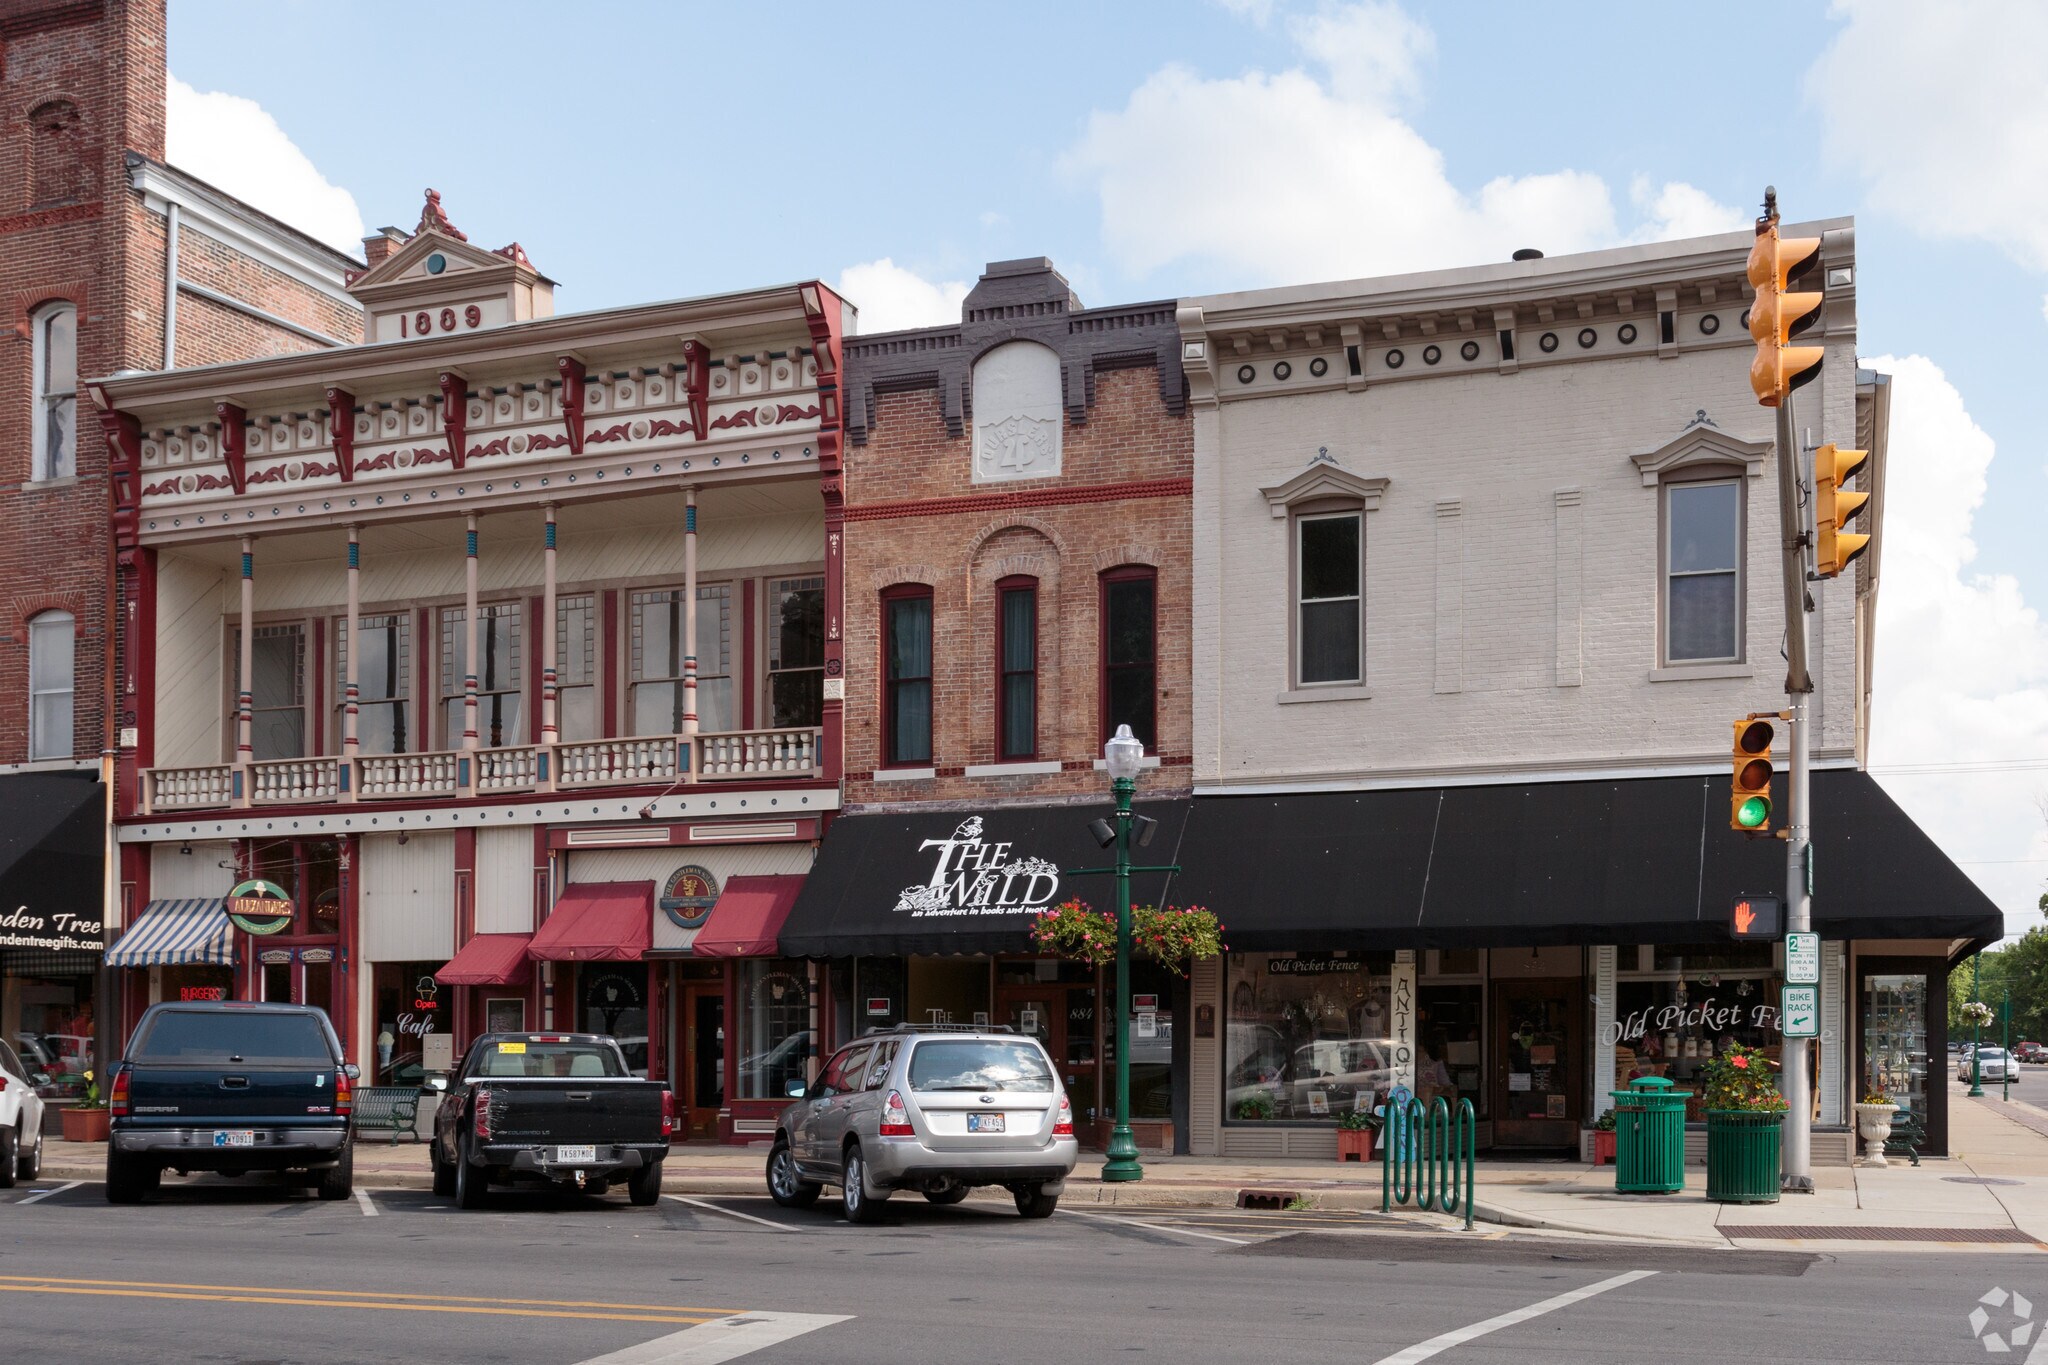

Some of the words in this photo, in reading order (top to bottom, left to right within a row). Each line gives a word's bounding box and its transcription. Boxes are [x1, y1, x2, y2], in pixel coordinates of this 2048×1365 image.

[401, 304, 481, 338] 1889
[918, 838, 1012, 900] THE
[937, 871, 1059, 907] WILD
[0, 905, 44, 930] den
[52, 913, 101, 934] Tree
[925, 908, 968, 917] adventure
[970, 907, 979, 915] in
[981, 905, 1005, 915] books
[1006, 905, 1023, 914] and
[1025, 906, 1048, 914] more
[1790, 938, 1797, 950] 2
[1271, 960, 1292, 972] Old
[1292, 959, 1325, 972] Picket
[1328, 960, 1360, 971] Fence
[180, 987, 222, 1002] BURGERS
[1789, 993, 1811, 1001] BIKE
[415, 999, 437, 1011] Open
[1069, 1007, 1094, 1020] 884
[396, 1012, 435, 1039] Cafe
[925, 1008, 953, 1030] THE
[1602, 1006, 1654, 1047] Old
[1656, 998, 1742, 1031] Picket
[1751, 1005, 1833, 1044] Fee
